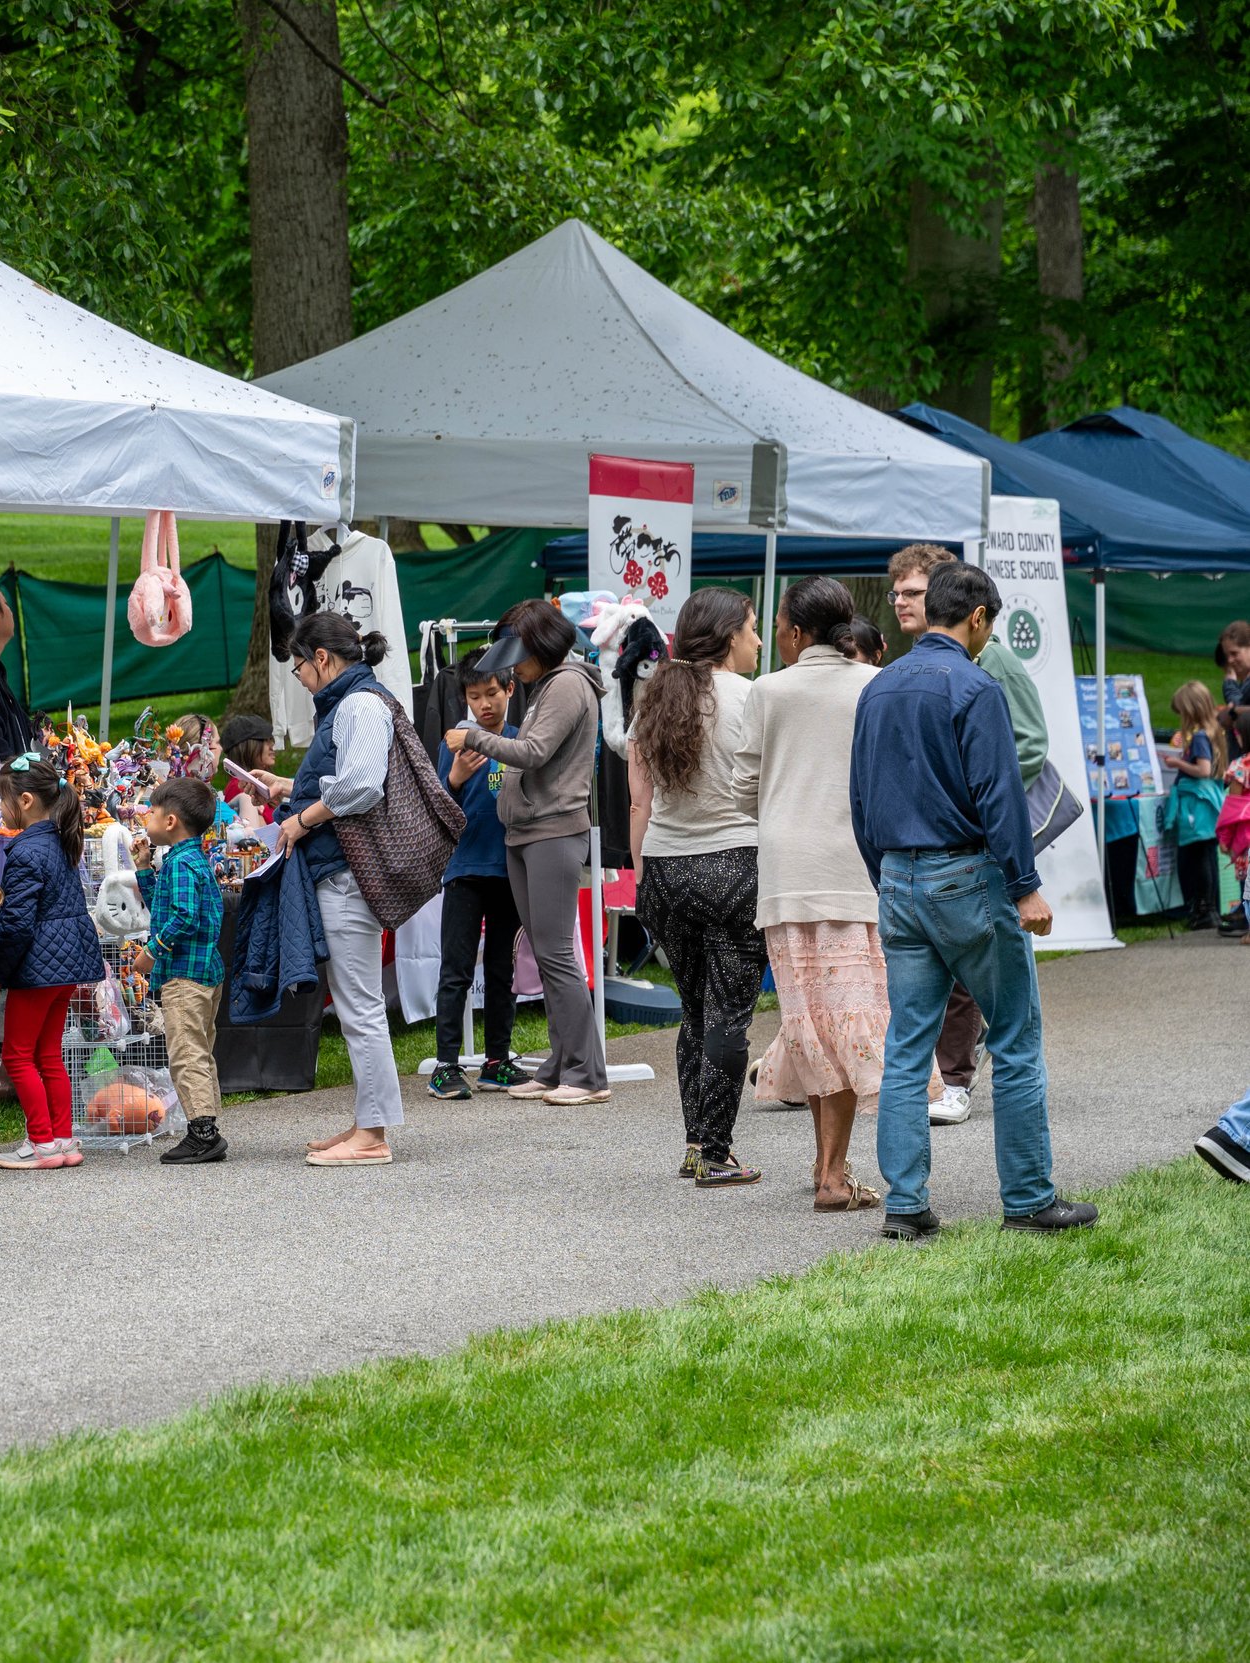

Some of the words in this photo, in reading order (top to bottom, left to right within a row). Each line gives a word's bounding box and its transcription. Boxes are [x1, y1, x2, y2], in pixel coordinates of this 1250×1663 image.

[986, 531, 1015, 551] WARD
[1017, 532, 1055, 552] COUNTY
[986, 559, 1017, 579] HINESE
[1019, 561, 1059, 580] SCHOOL
